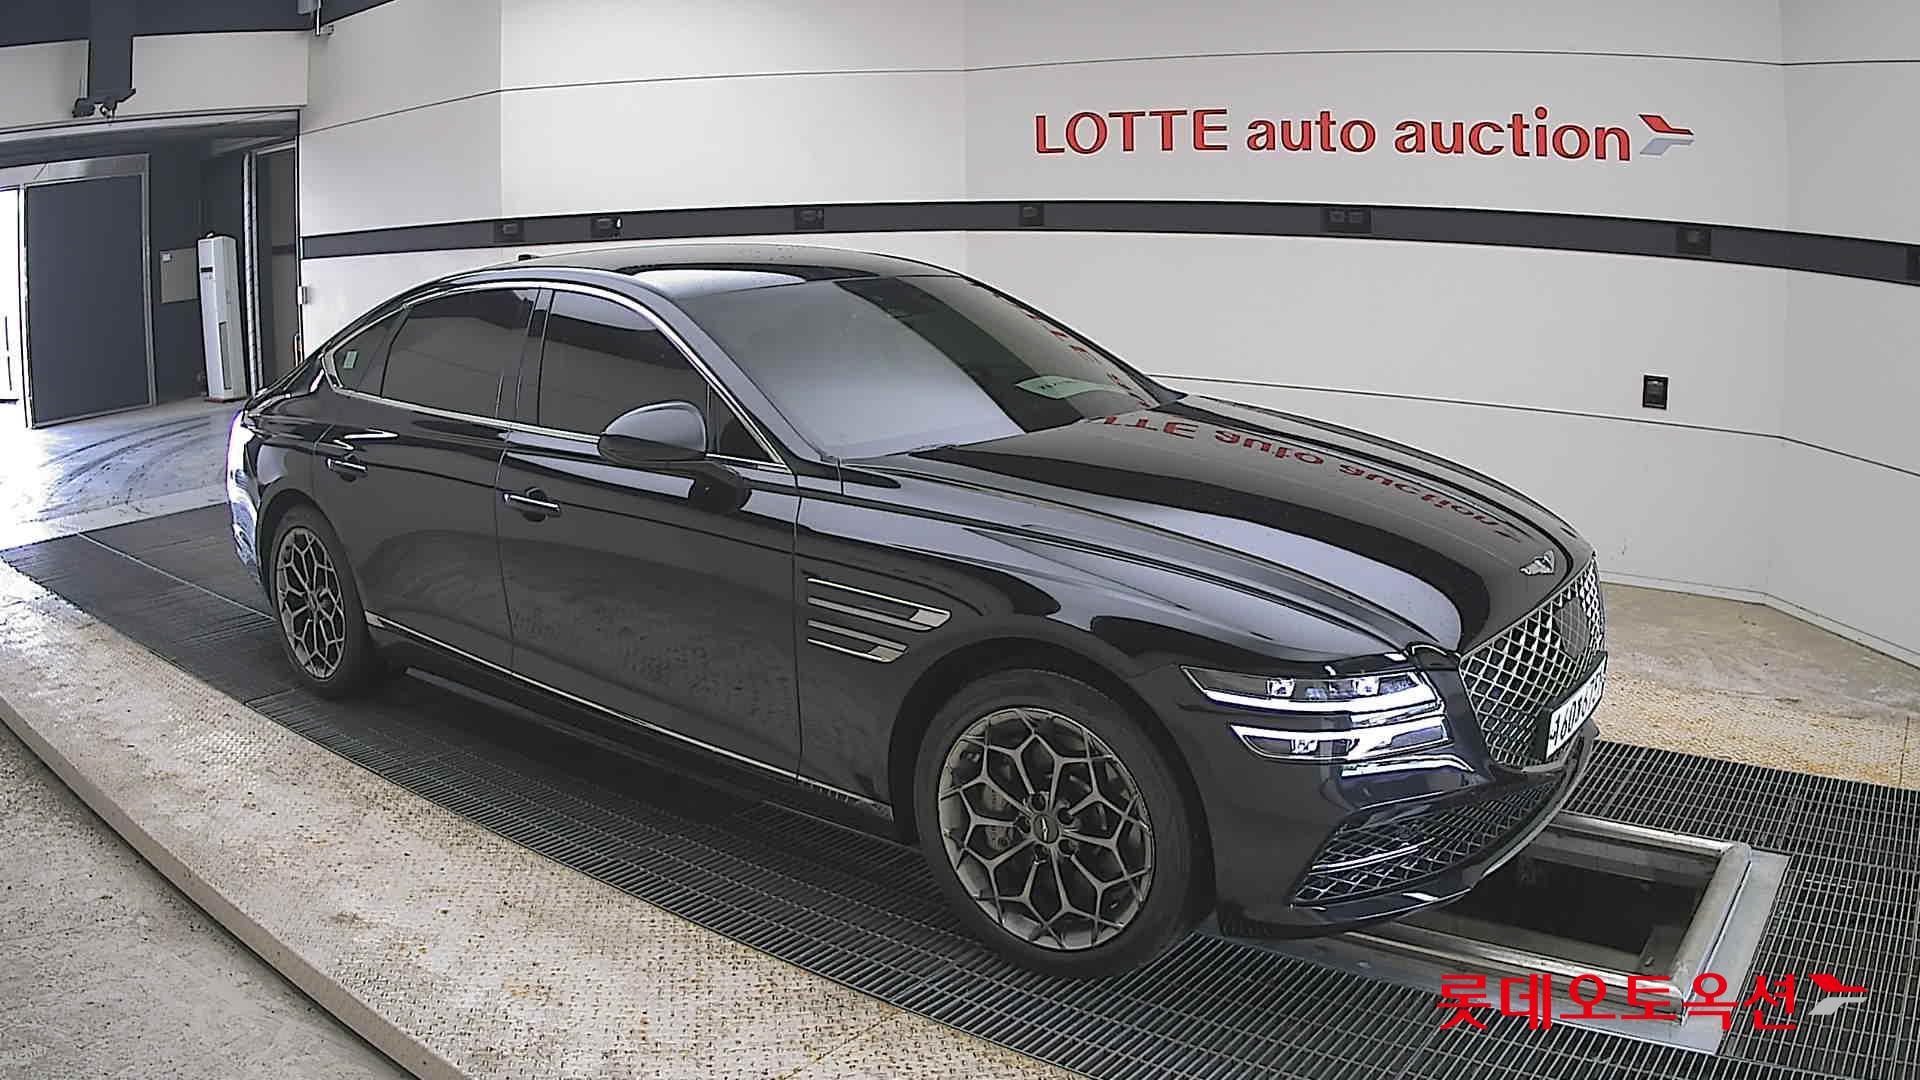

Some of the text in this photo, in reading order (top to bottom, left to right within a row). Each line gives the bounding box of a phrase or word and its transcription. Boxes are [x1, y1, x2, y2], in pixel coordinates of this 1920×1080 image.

[1035, 107, 1630, 161] LOTTE auto auction
